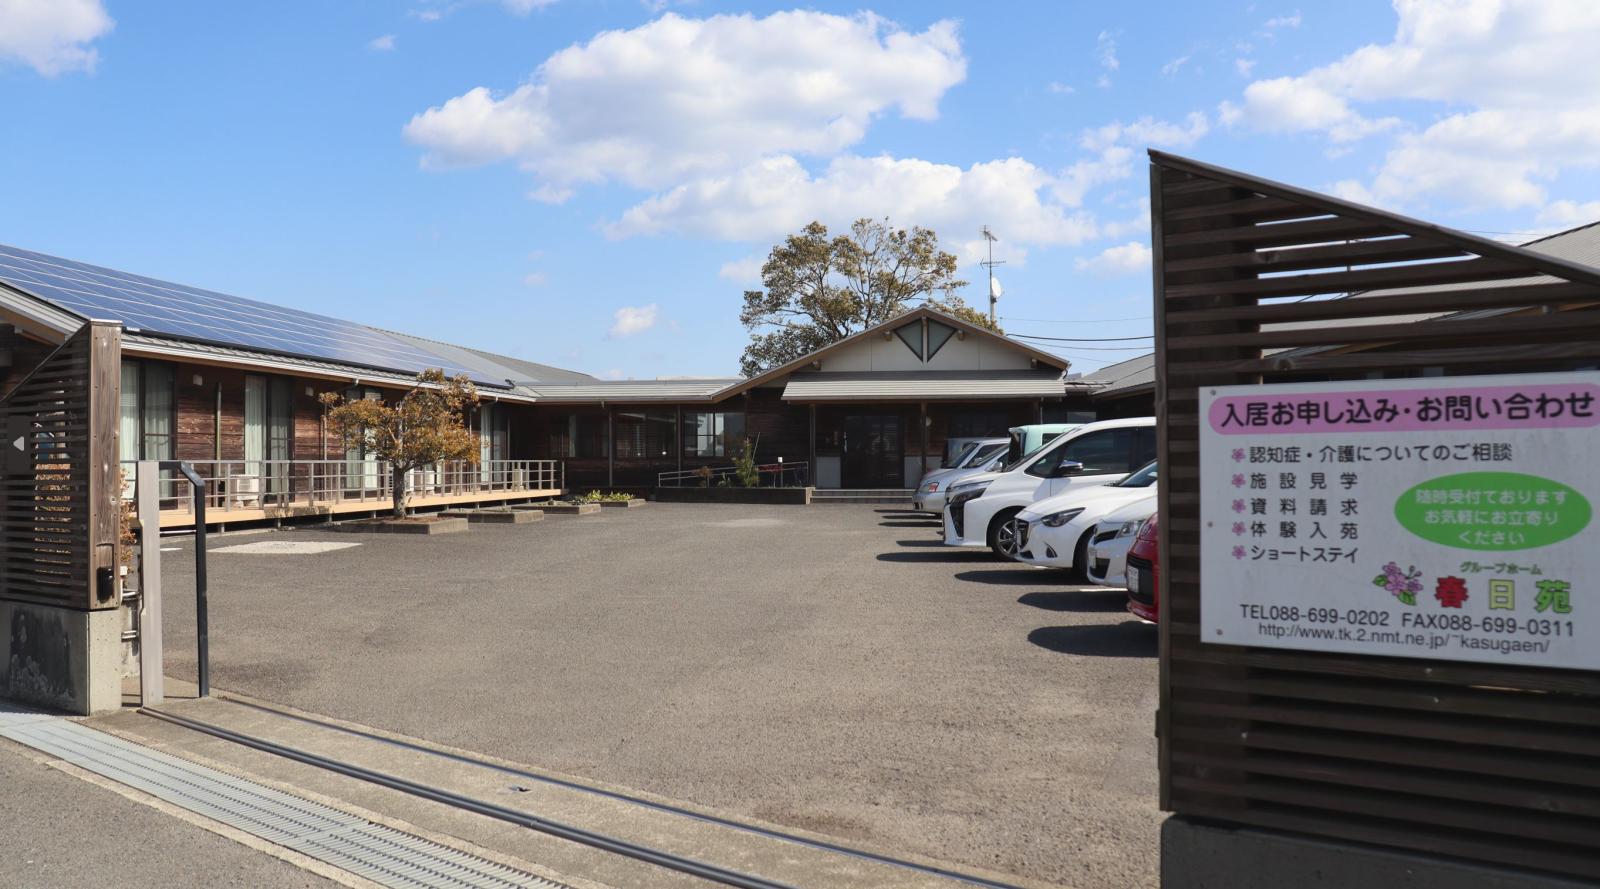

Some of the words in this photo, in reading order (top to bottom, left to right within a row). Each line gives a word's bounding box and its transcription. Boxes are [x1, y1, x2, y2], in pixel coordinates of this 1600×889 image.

[1221, 391, 1595, 427] 入居お申し込み・お問い合わせ
[1249, 442, 1513, 464] 認知症・介護についてのご相談
[1250, 472, 1359, 490] 施設見学
[1250, 498, 1359, 516] 資料請求
[1424, 509, 1559, 526] お気軽にお立寄り
[1250, 521, 1359, 540] 体験入苑
[1458, 530, 1525, 545] ください
[1250, 545, 1359, 564] ショートステイ
[1459, 560, 1543, 576] グループホーム
[1434, 575, 1573, 615] 春日苑
[1240, 603, 1390, 627] TEL088-699-0202
[1402, 613, 1574, 638] FAX088-699-0311
